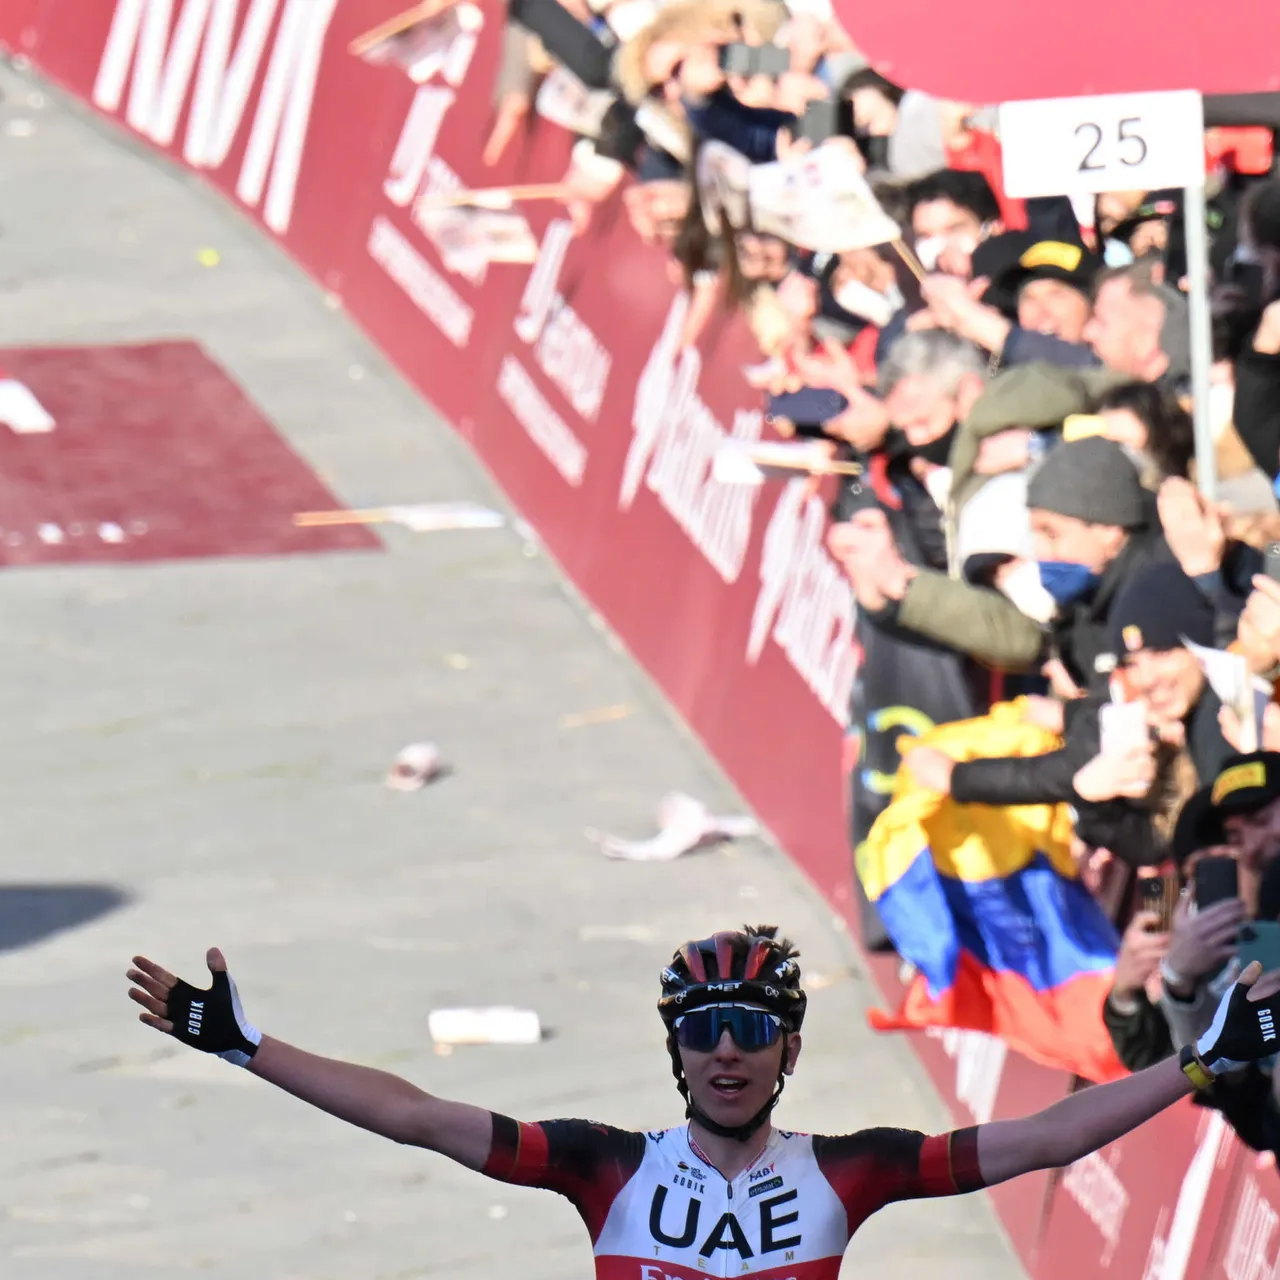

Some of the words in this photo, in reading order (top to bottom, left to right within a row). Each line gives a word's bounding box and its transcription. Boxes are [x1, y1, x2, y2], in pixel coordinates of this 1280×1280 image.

[1074, 117, 1149, 172] 25
[707, 981, 743, 992] MET
[187, 1000, 205, 1036] GOBIK
[1257, 1008, 1277, 1043] GOBIK
[673, 1174, 705, 1194] GOBIK
[749, 1167, 771, 1182] FAB
[649, 1184, 802, 1260] UAE
